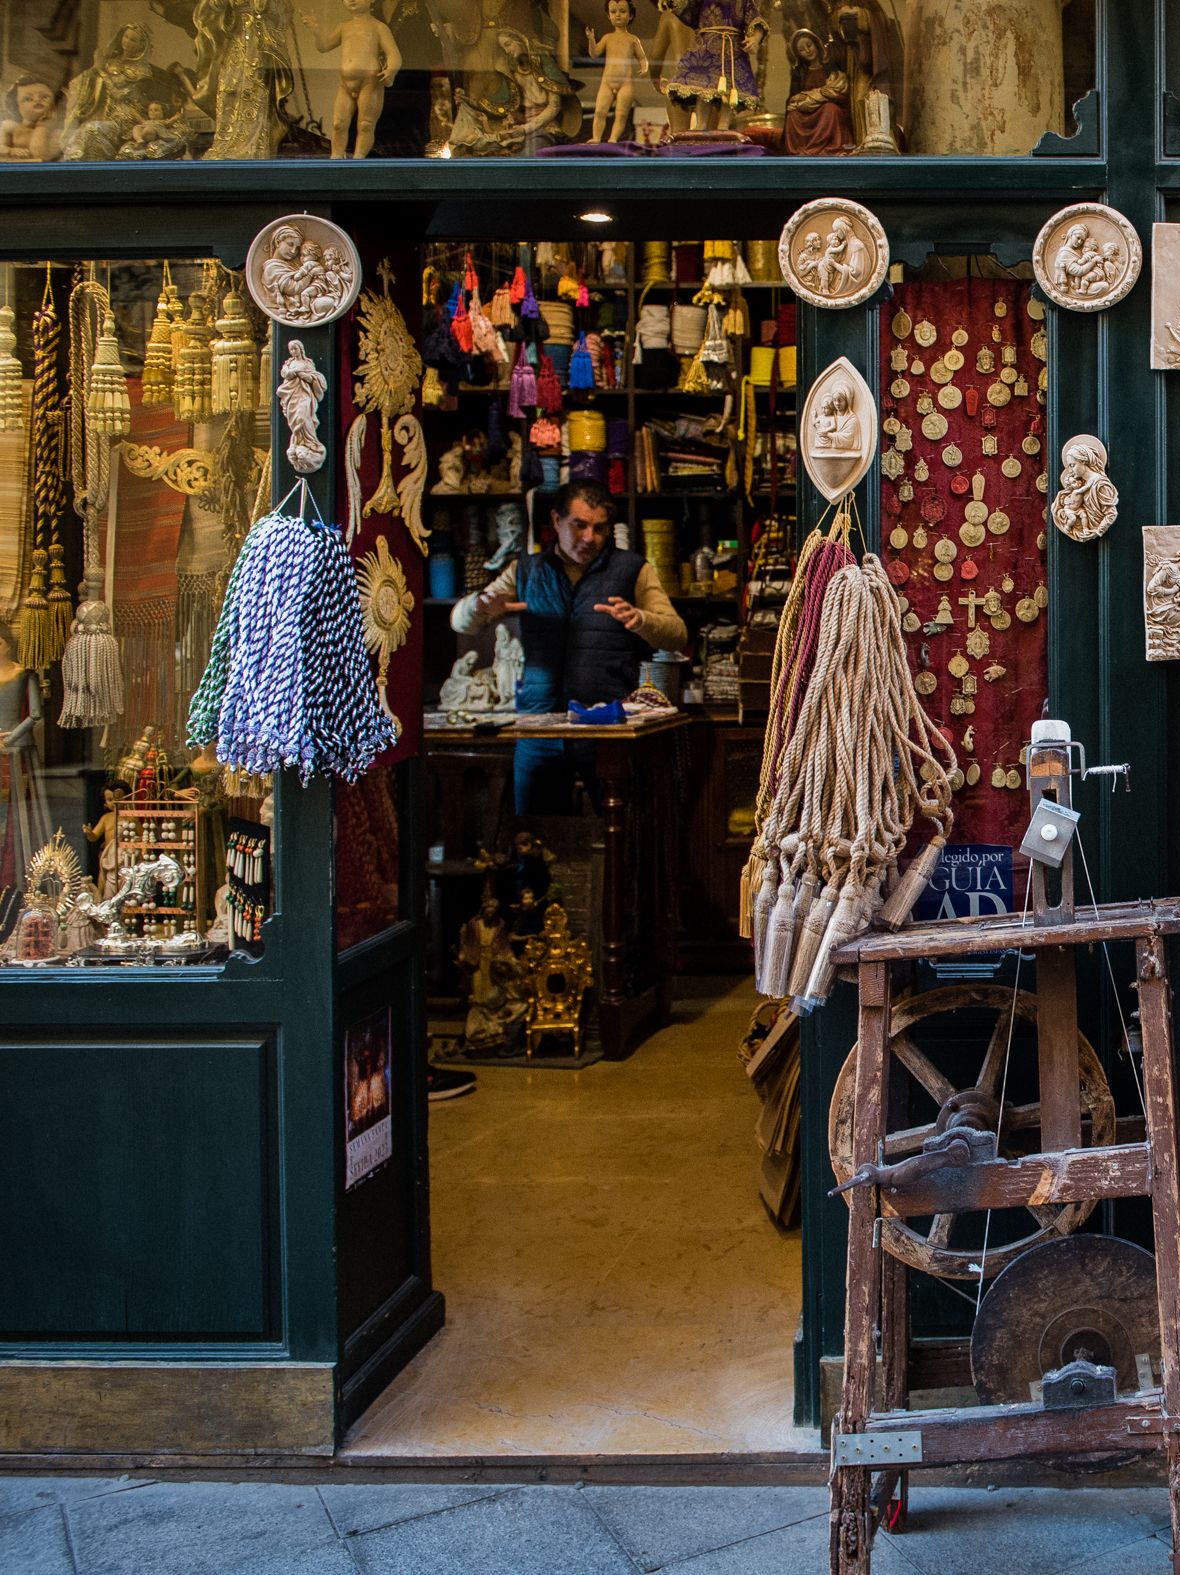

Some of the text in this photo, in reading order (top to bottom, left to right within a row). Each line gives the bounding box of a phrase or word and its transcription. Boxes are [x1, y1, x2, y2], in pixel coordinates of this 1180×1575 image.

[941, 847, 1004, 866] legido por
[928, 861, 1008, 891] GUÍA
